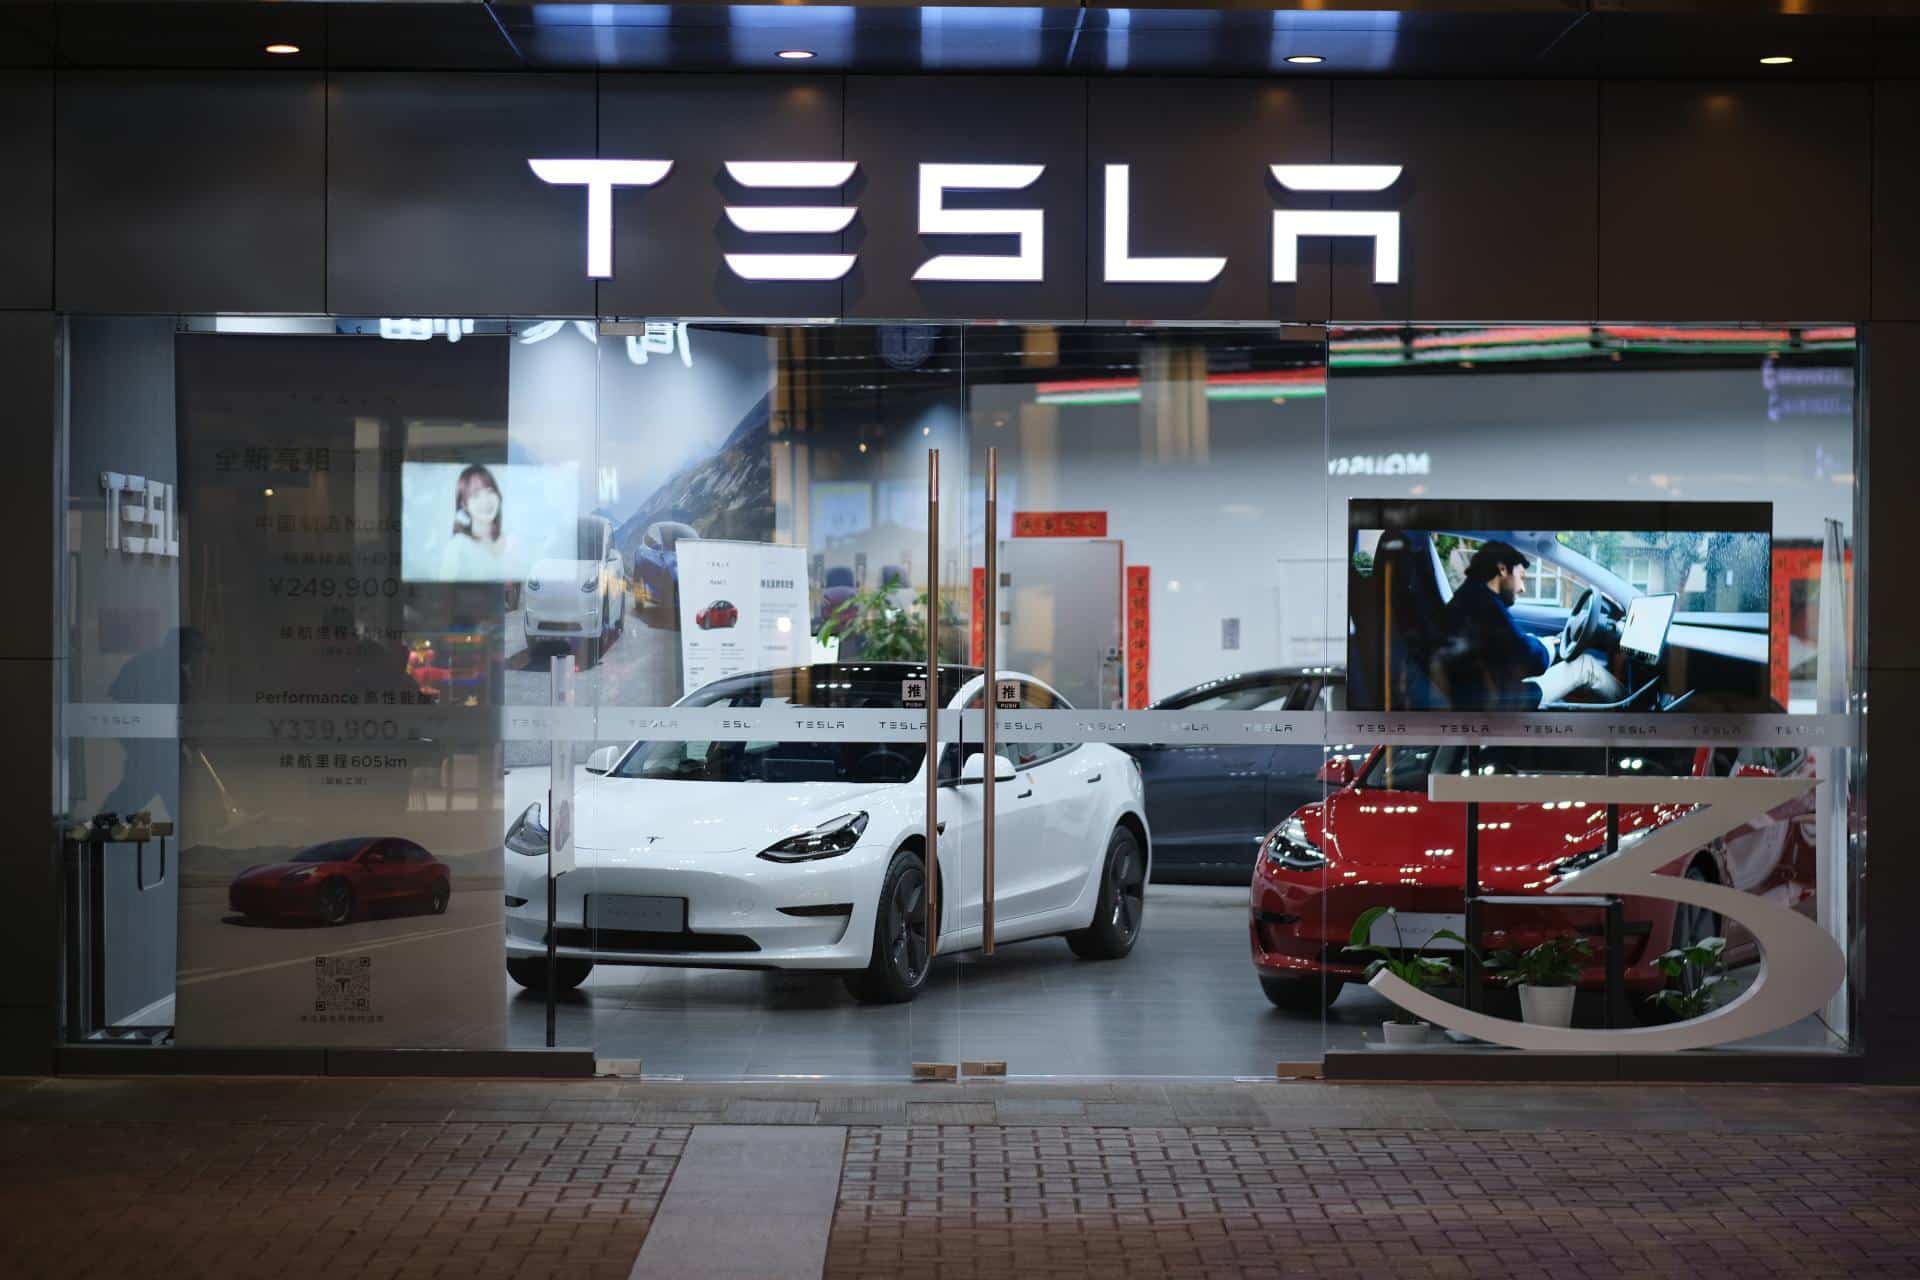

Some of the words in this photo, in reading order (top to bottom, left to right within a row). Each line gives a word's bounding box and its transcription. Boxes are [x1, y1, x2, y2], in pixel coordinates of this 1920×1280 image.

[528, 159, 1404, 283] TESLA
[256, 689, 362, 706] Performance
[907, 684, 921, 698] 推
[1002, 684, 1016, 699] 推
[795, 720, 845, 729] TESLA
[879, 721, 928, 730] TESLA
[1356, 723, 1406, 733] TESLA
[1440, 724, 1489, 734] TESLA
[1524, 724, 1574, 734] TESLA
[1608, 725, 1657, 735] TESLA
[1368, 773, 1847, 1051] 3
